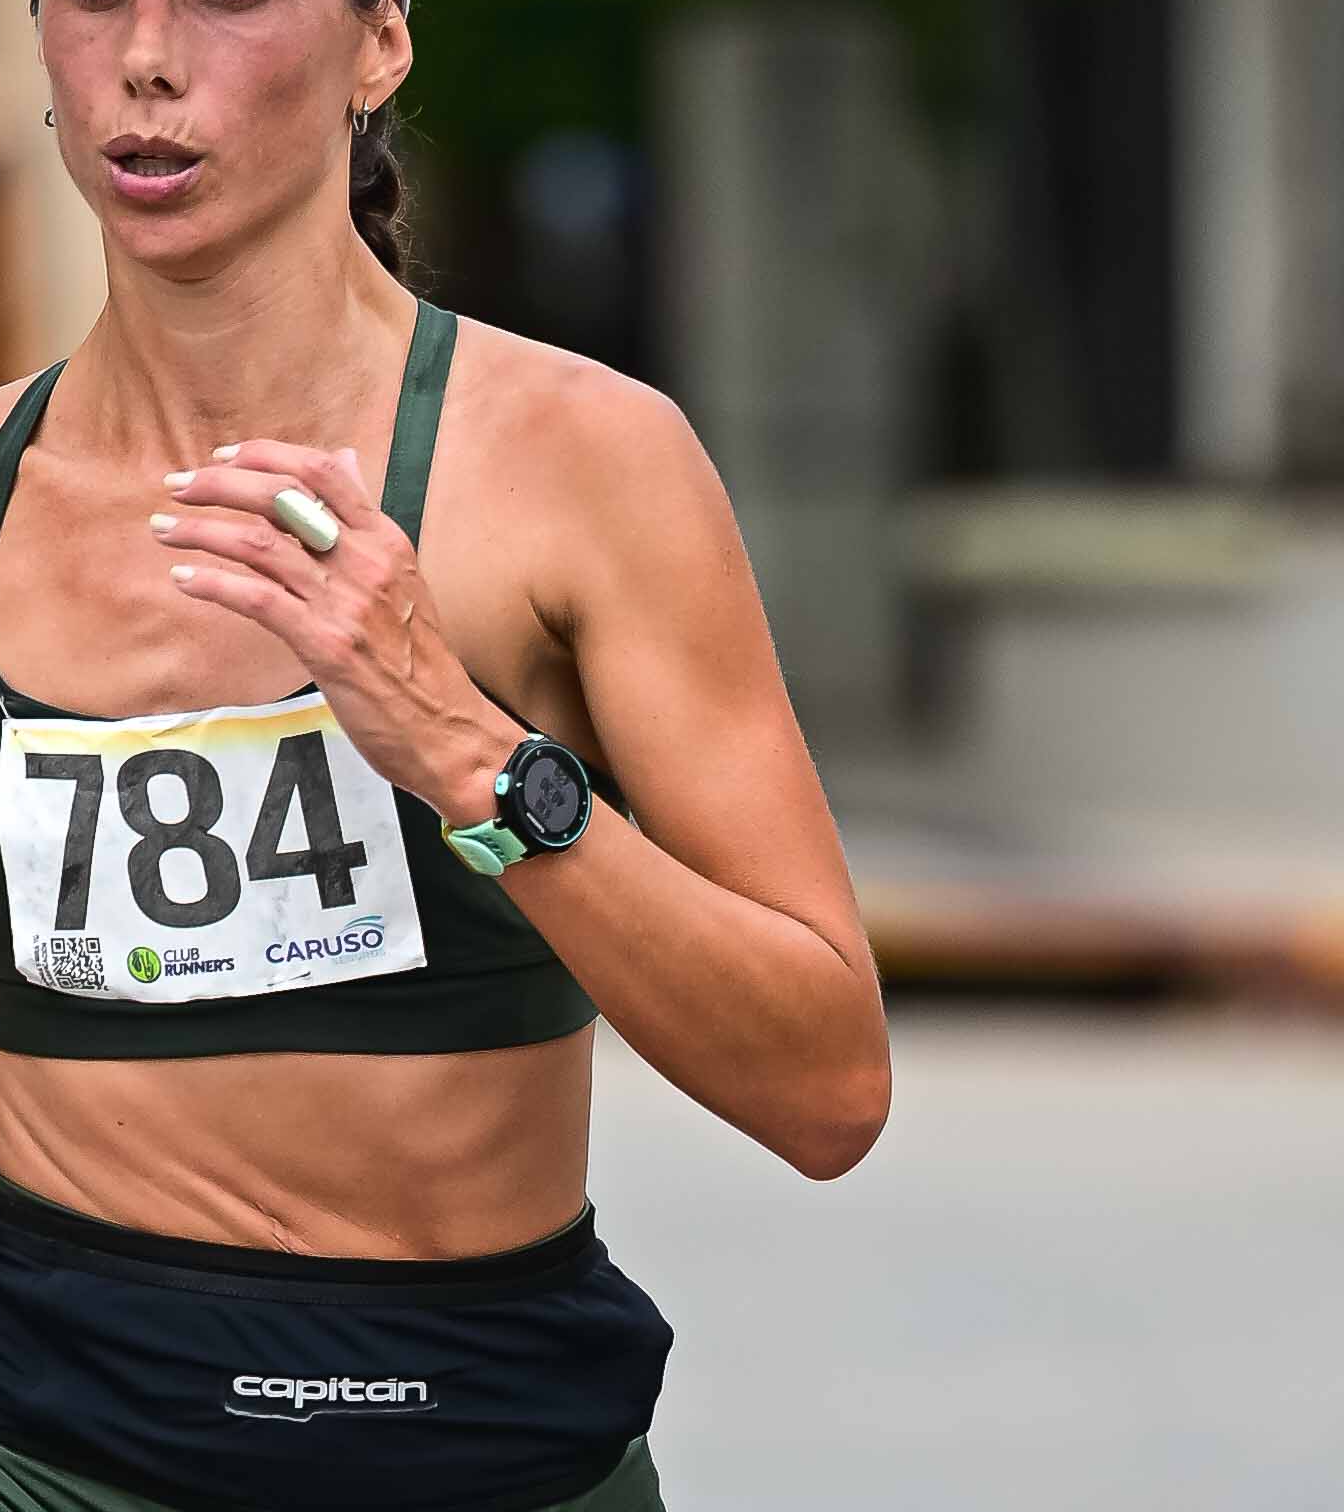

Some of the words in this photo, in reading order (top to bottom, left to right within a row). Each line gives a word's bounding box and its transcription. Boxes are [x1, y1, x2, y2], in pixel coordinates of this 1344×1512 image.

[25, 729, 369, 931] 784
[163, 947, 200, 963] CLUB
[265, 928, 384, 964] CARUSO
[164, 957, 236, 977] RUNNER'S
